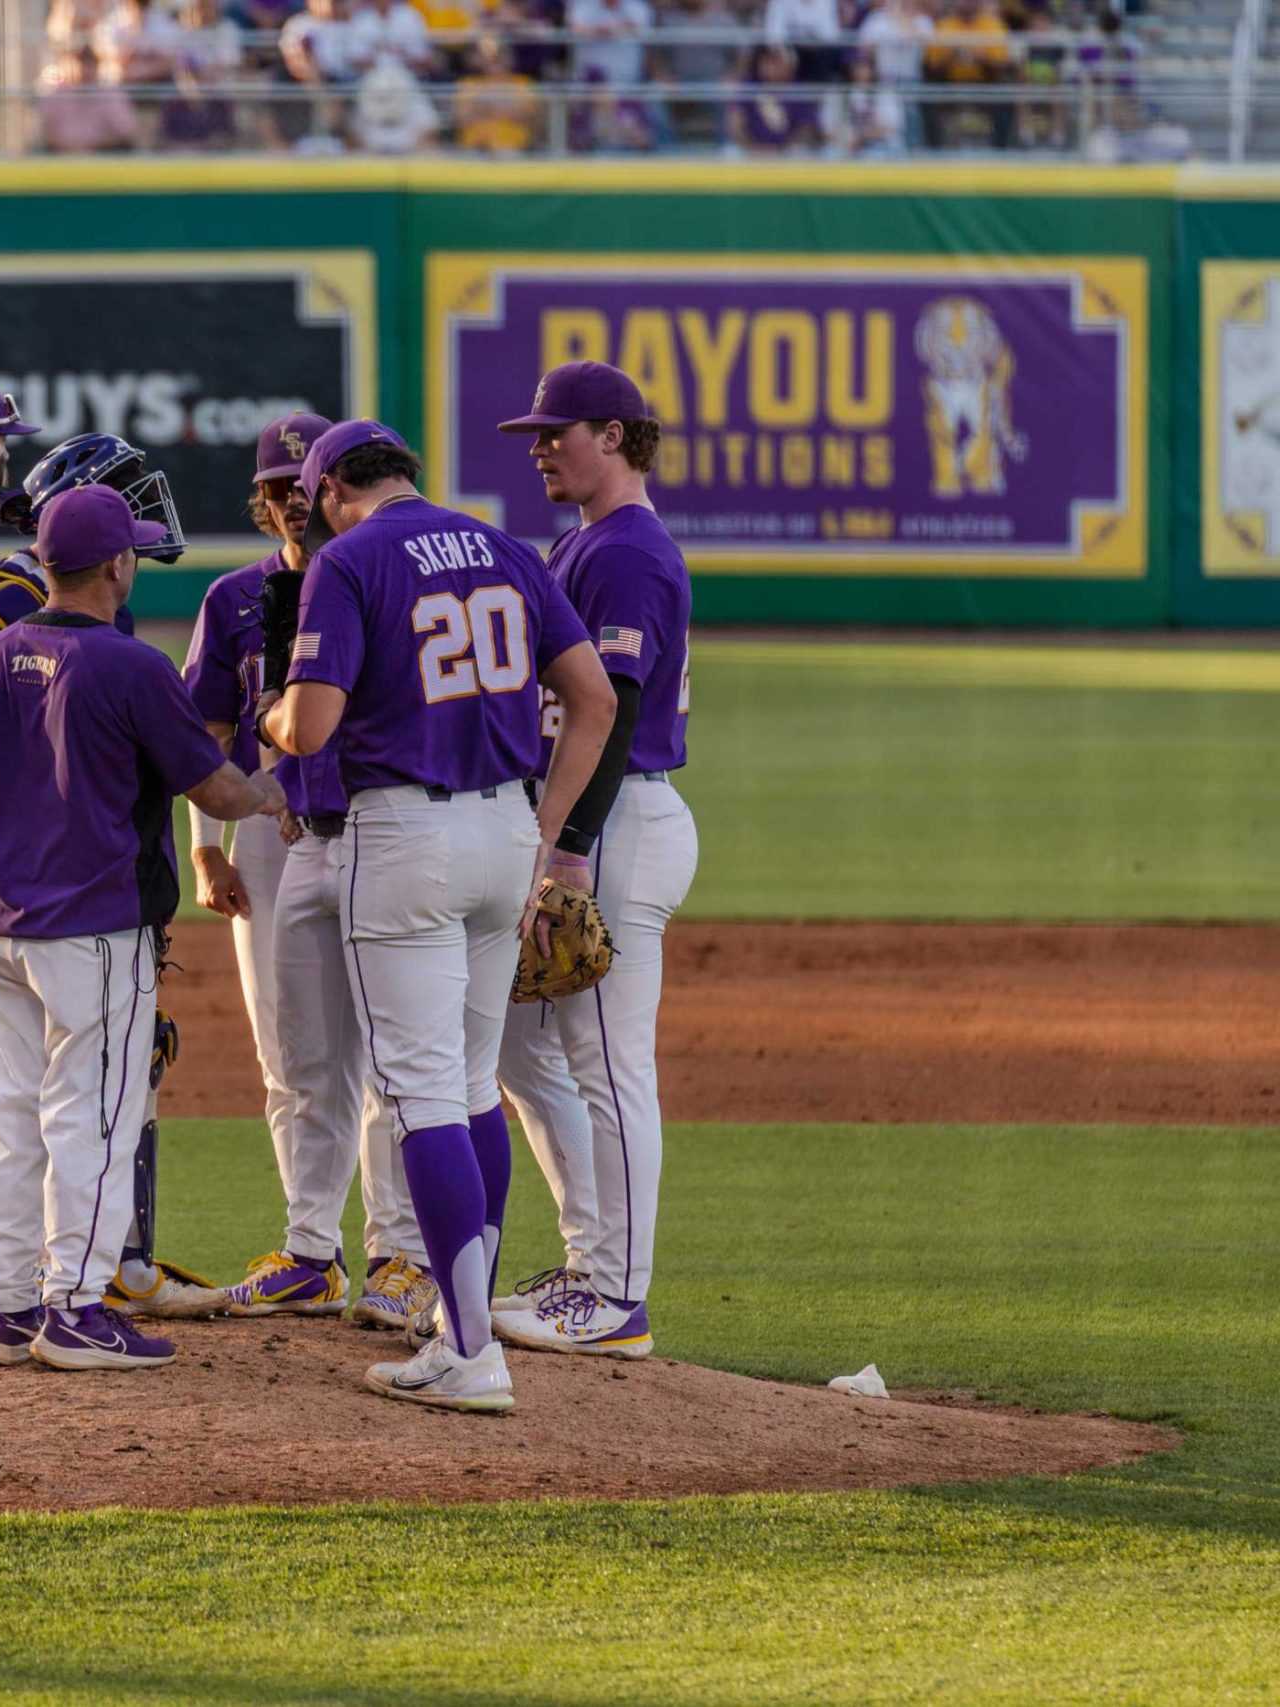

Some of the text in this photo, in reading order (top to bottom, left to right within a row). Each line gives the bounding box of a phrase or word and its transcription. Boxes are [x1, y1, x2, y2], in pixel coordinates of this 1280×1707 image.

[404, 531, 495, 576] SKENES
[11, 654, 58, 679] TIGERS
[411, 584, 531, 705] 20
